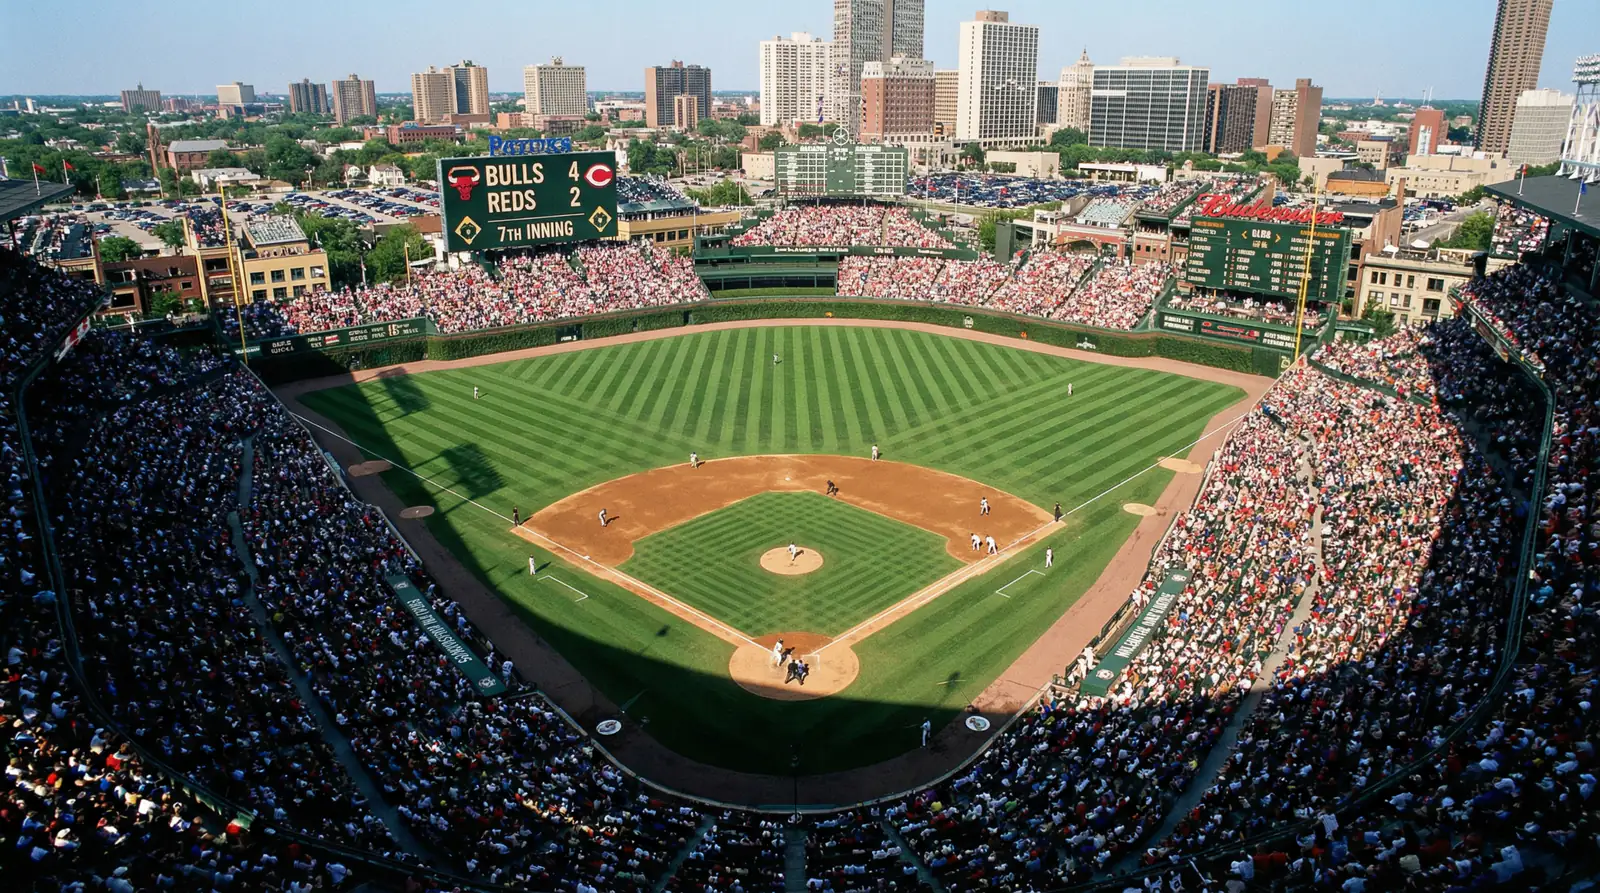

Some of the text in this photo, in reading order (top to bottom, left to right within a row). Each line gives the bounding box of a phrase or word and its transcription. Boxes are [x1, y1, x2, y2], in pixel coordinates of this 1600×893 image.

[485, 161, 580, 187] BULLS 4
[487, 186, 581, 213] REDS 2
[497, 220, 574, 242] 7TH INNING
